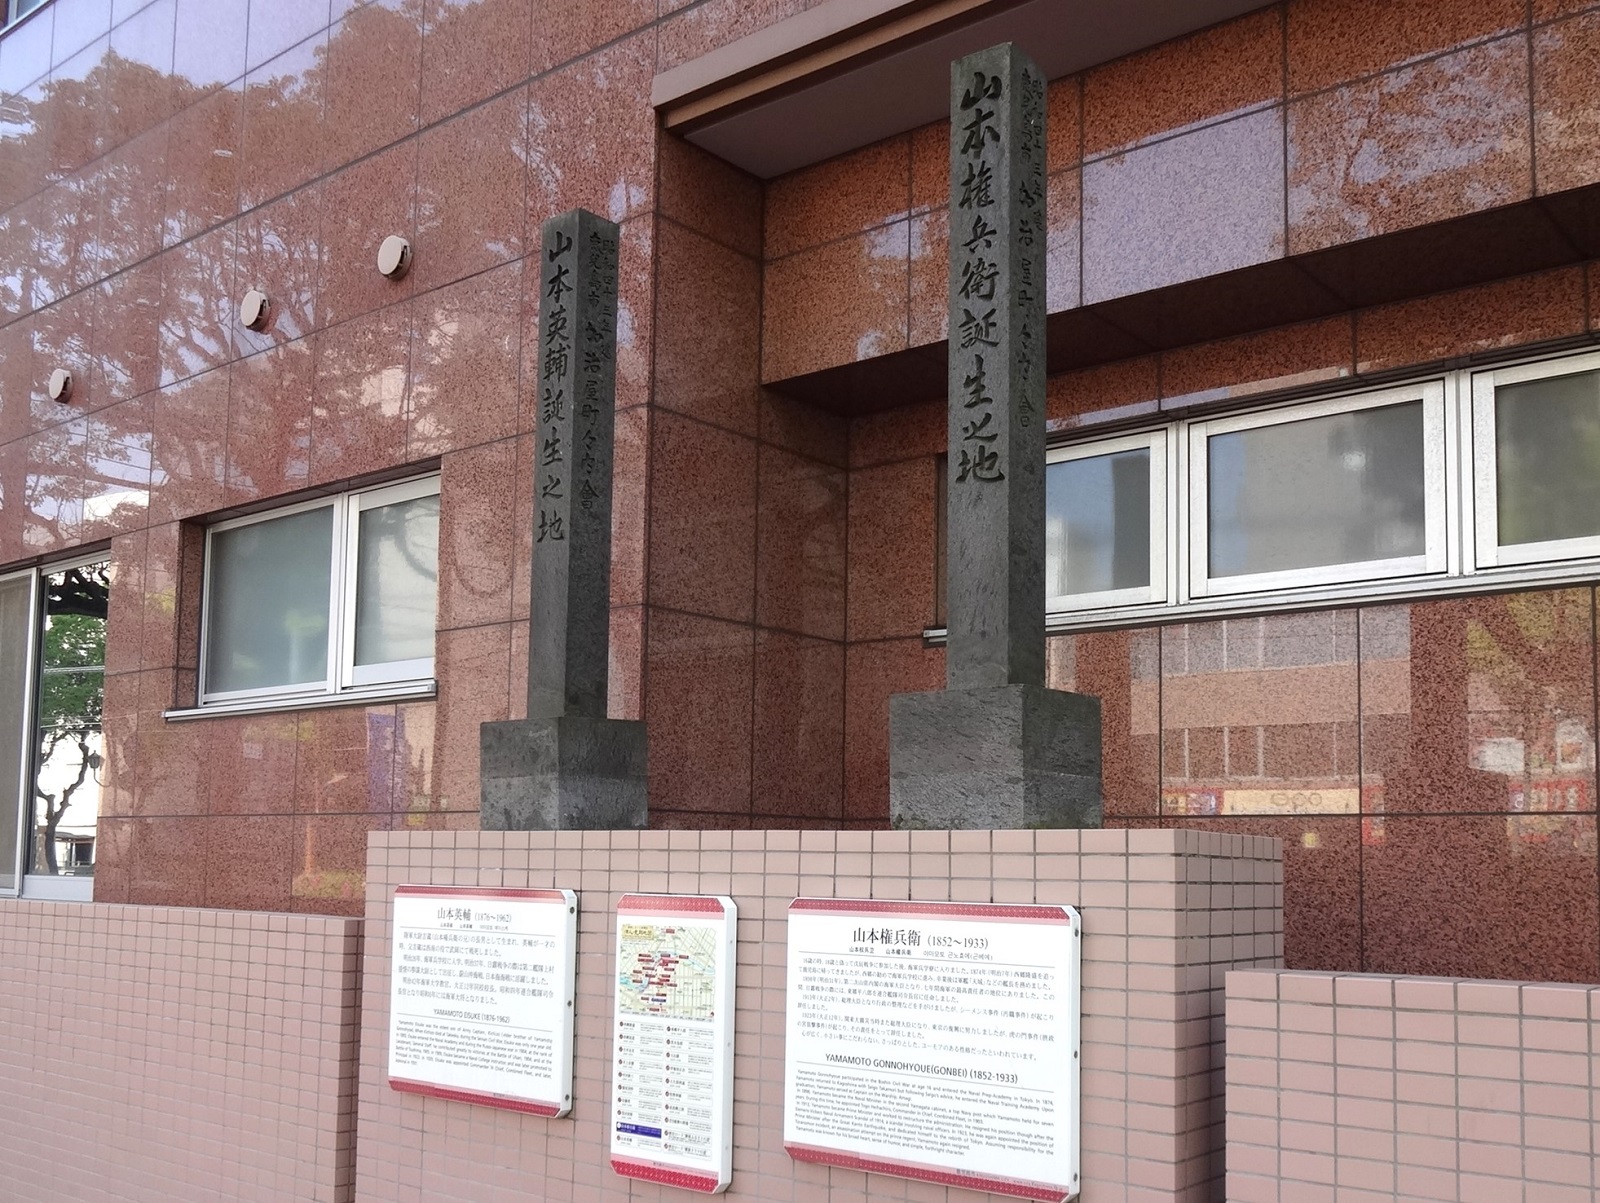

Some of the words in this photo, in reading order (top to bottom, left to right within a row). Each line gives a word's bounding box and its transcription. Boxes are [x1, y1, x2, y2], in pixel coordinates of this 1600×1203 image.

[955, 71, 1005, 484] 山本権兵衛誕生之地
[537, 230, 573, 543] 山本英輔誕生之地
[437, 907, 471, 921] 山本英輔
[854, 927, 921, 947] 山本権兵衛
[434, 1008, 464, 1020] YAMAMOTO
[825, 1053, 872, 1067] YAMAMOTO
[873, 1058, 967, 1078] GONNOHYOUE(GONBEI)
[969, 1069, 1018, 1084] (1852-1933)
